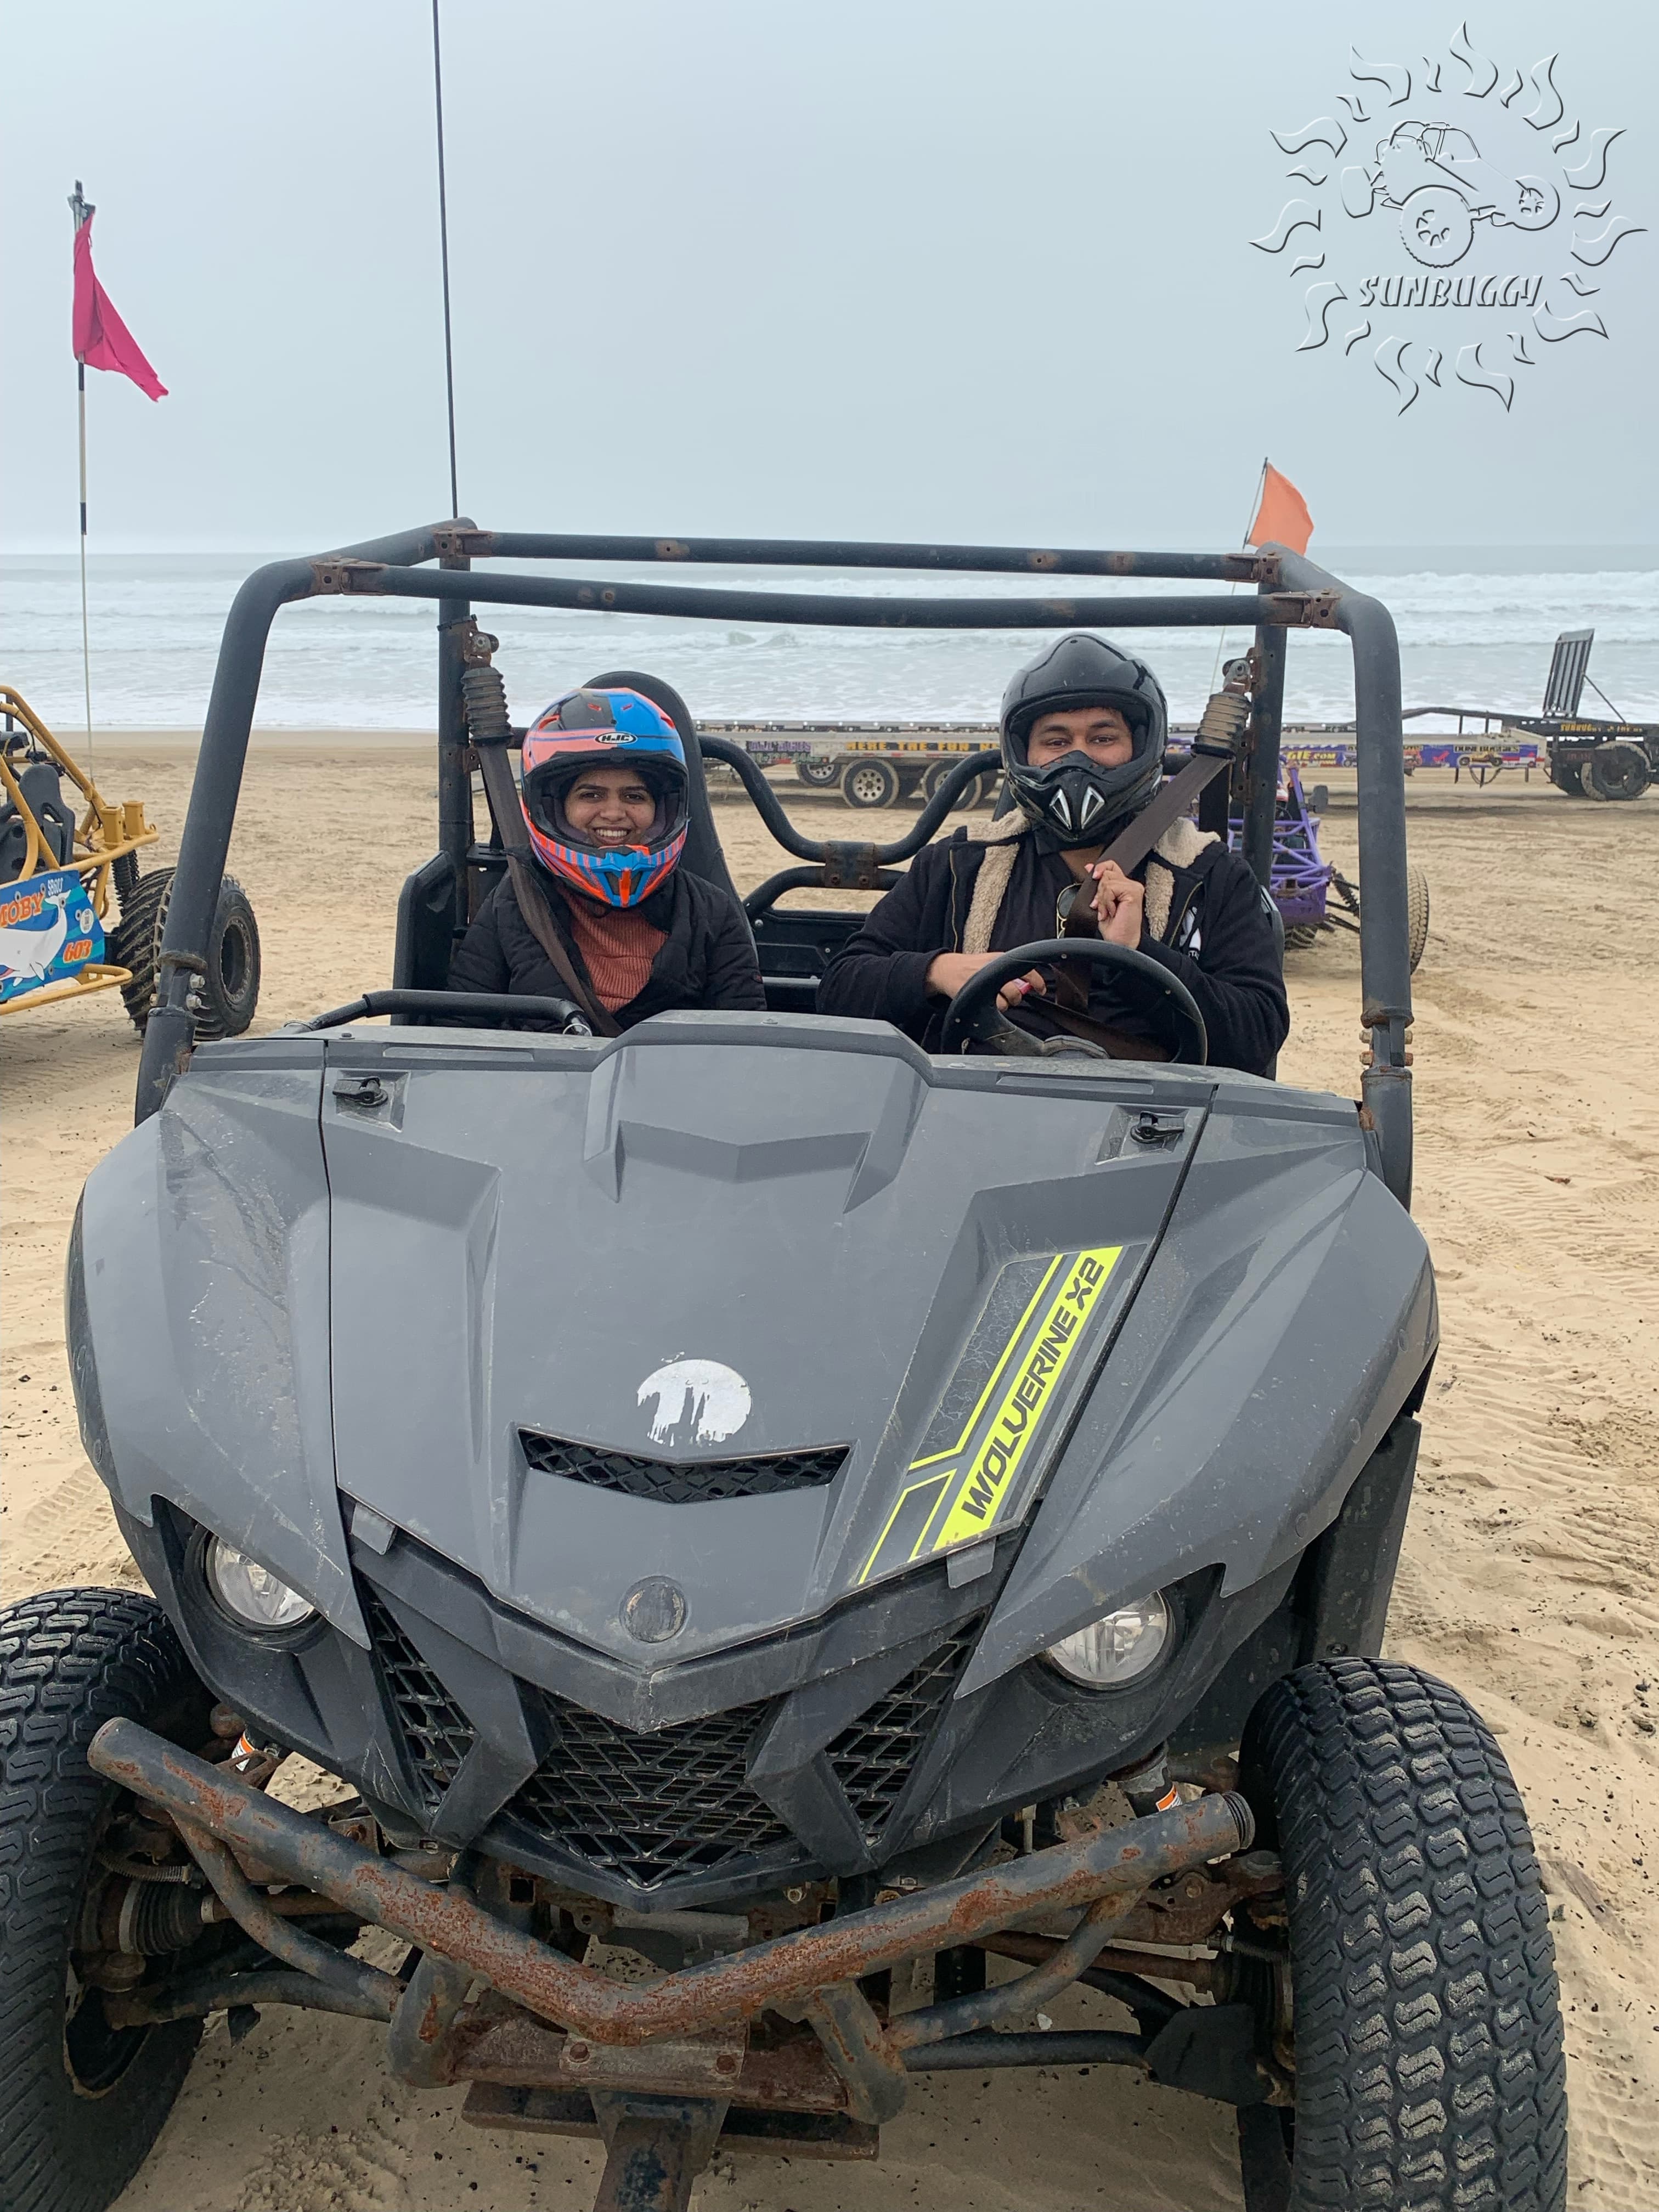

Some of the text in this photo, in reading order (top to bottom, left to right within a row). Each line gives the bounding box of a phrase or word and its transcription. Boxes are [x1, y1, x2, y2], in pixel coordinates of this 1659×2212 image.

[898, 742, 927, 751] THE
[938, 742, 969, 751] FUN
[63, 939, 93, 963] 603
[961, 1257, 1104, 1520] WOLVERINE X2
